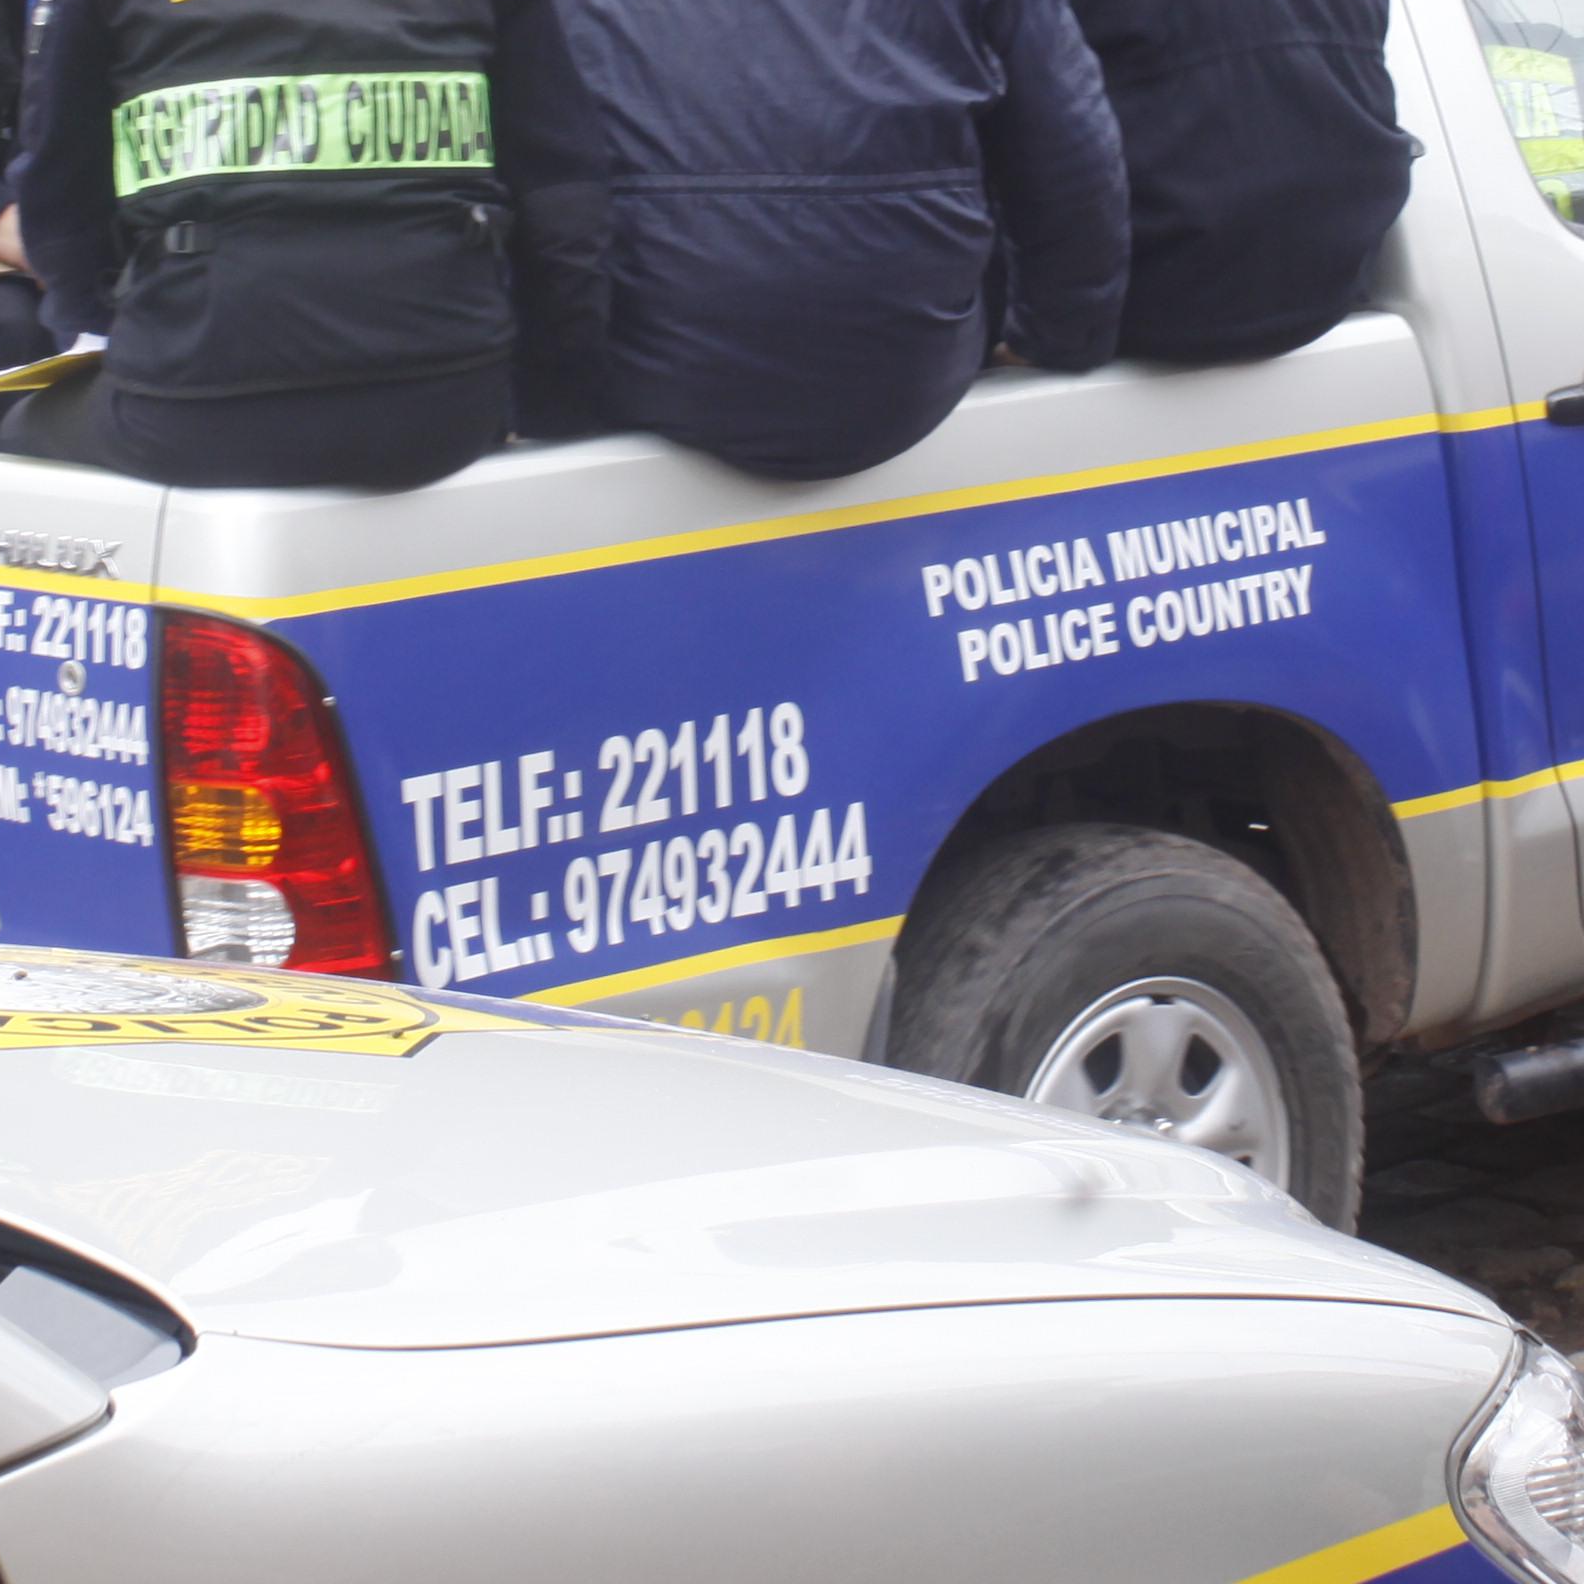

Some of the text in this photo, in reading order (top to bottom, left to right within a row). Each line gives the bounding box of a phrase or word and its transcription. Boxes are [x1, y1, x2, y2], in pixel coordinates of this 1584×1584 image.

[922, 498, 1325, 617] POLICIA MUNICIPAL
[30, 595, 148, 670] 221118
[957, 564, 1315, 684] POLICE COUNTRY
[4, 686, 150, 766] 974932444
[401, 700, 809, 871] TELF.: 221118
[414, 801, 874, 990] CEL.: 974932444
